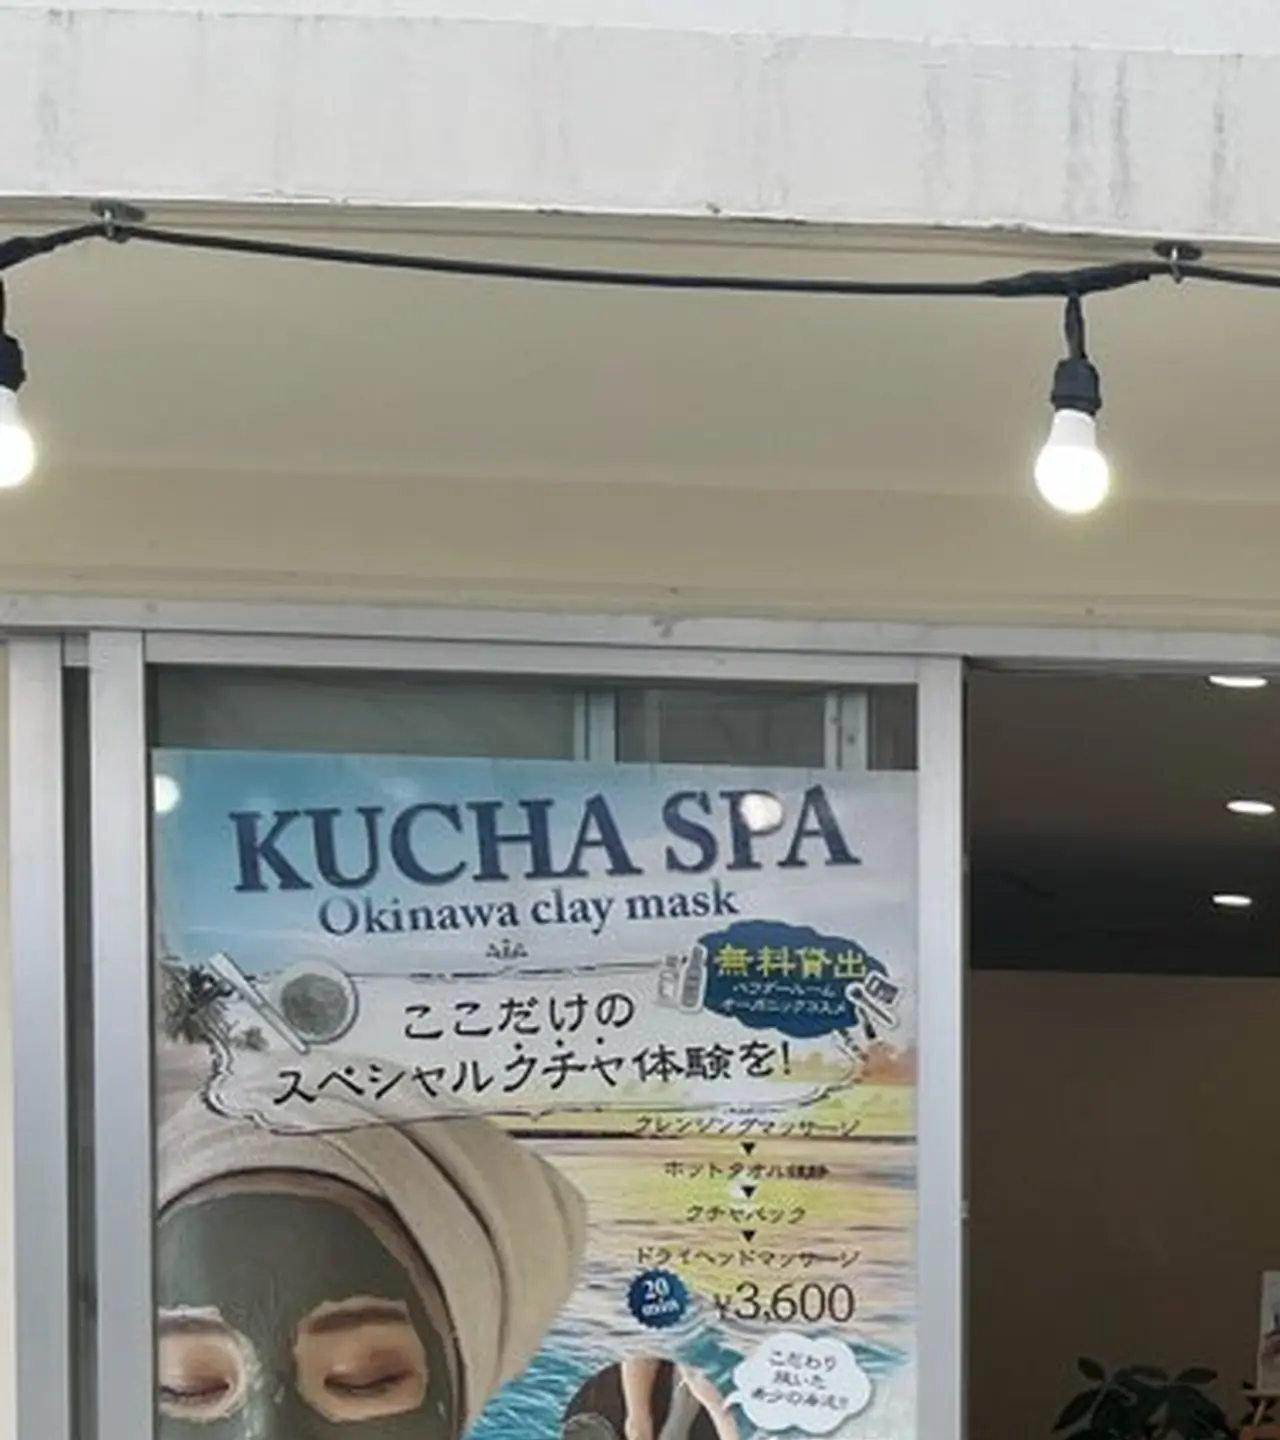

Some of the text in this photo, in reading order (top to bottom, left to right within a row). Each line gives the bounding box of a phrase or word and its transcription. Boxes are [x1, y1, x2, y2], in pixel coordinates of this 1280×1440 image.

[229, 784, 861, 892] KUCHA SPA
[318, 882, 740, 937] Okinawa clay mask
[713, 942, 867, 980] 無料貸出
[402, 992, 636, 1041] ここだけの
[635, 1114, 862, 1138] クレンジングマッサージ
[687, 1205, 806, 1225] クチャパック
[636, 1247, 862, 1269] ドライヘッドマッサージ
[713, 1281, 855, 1324] ¥3,600
